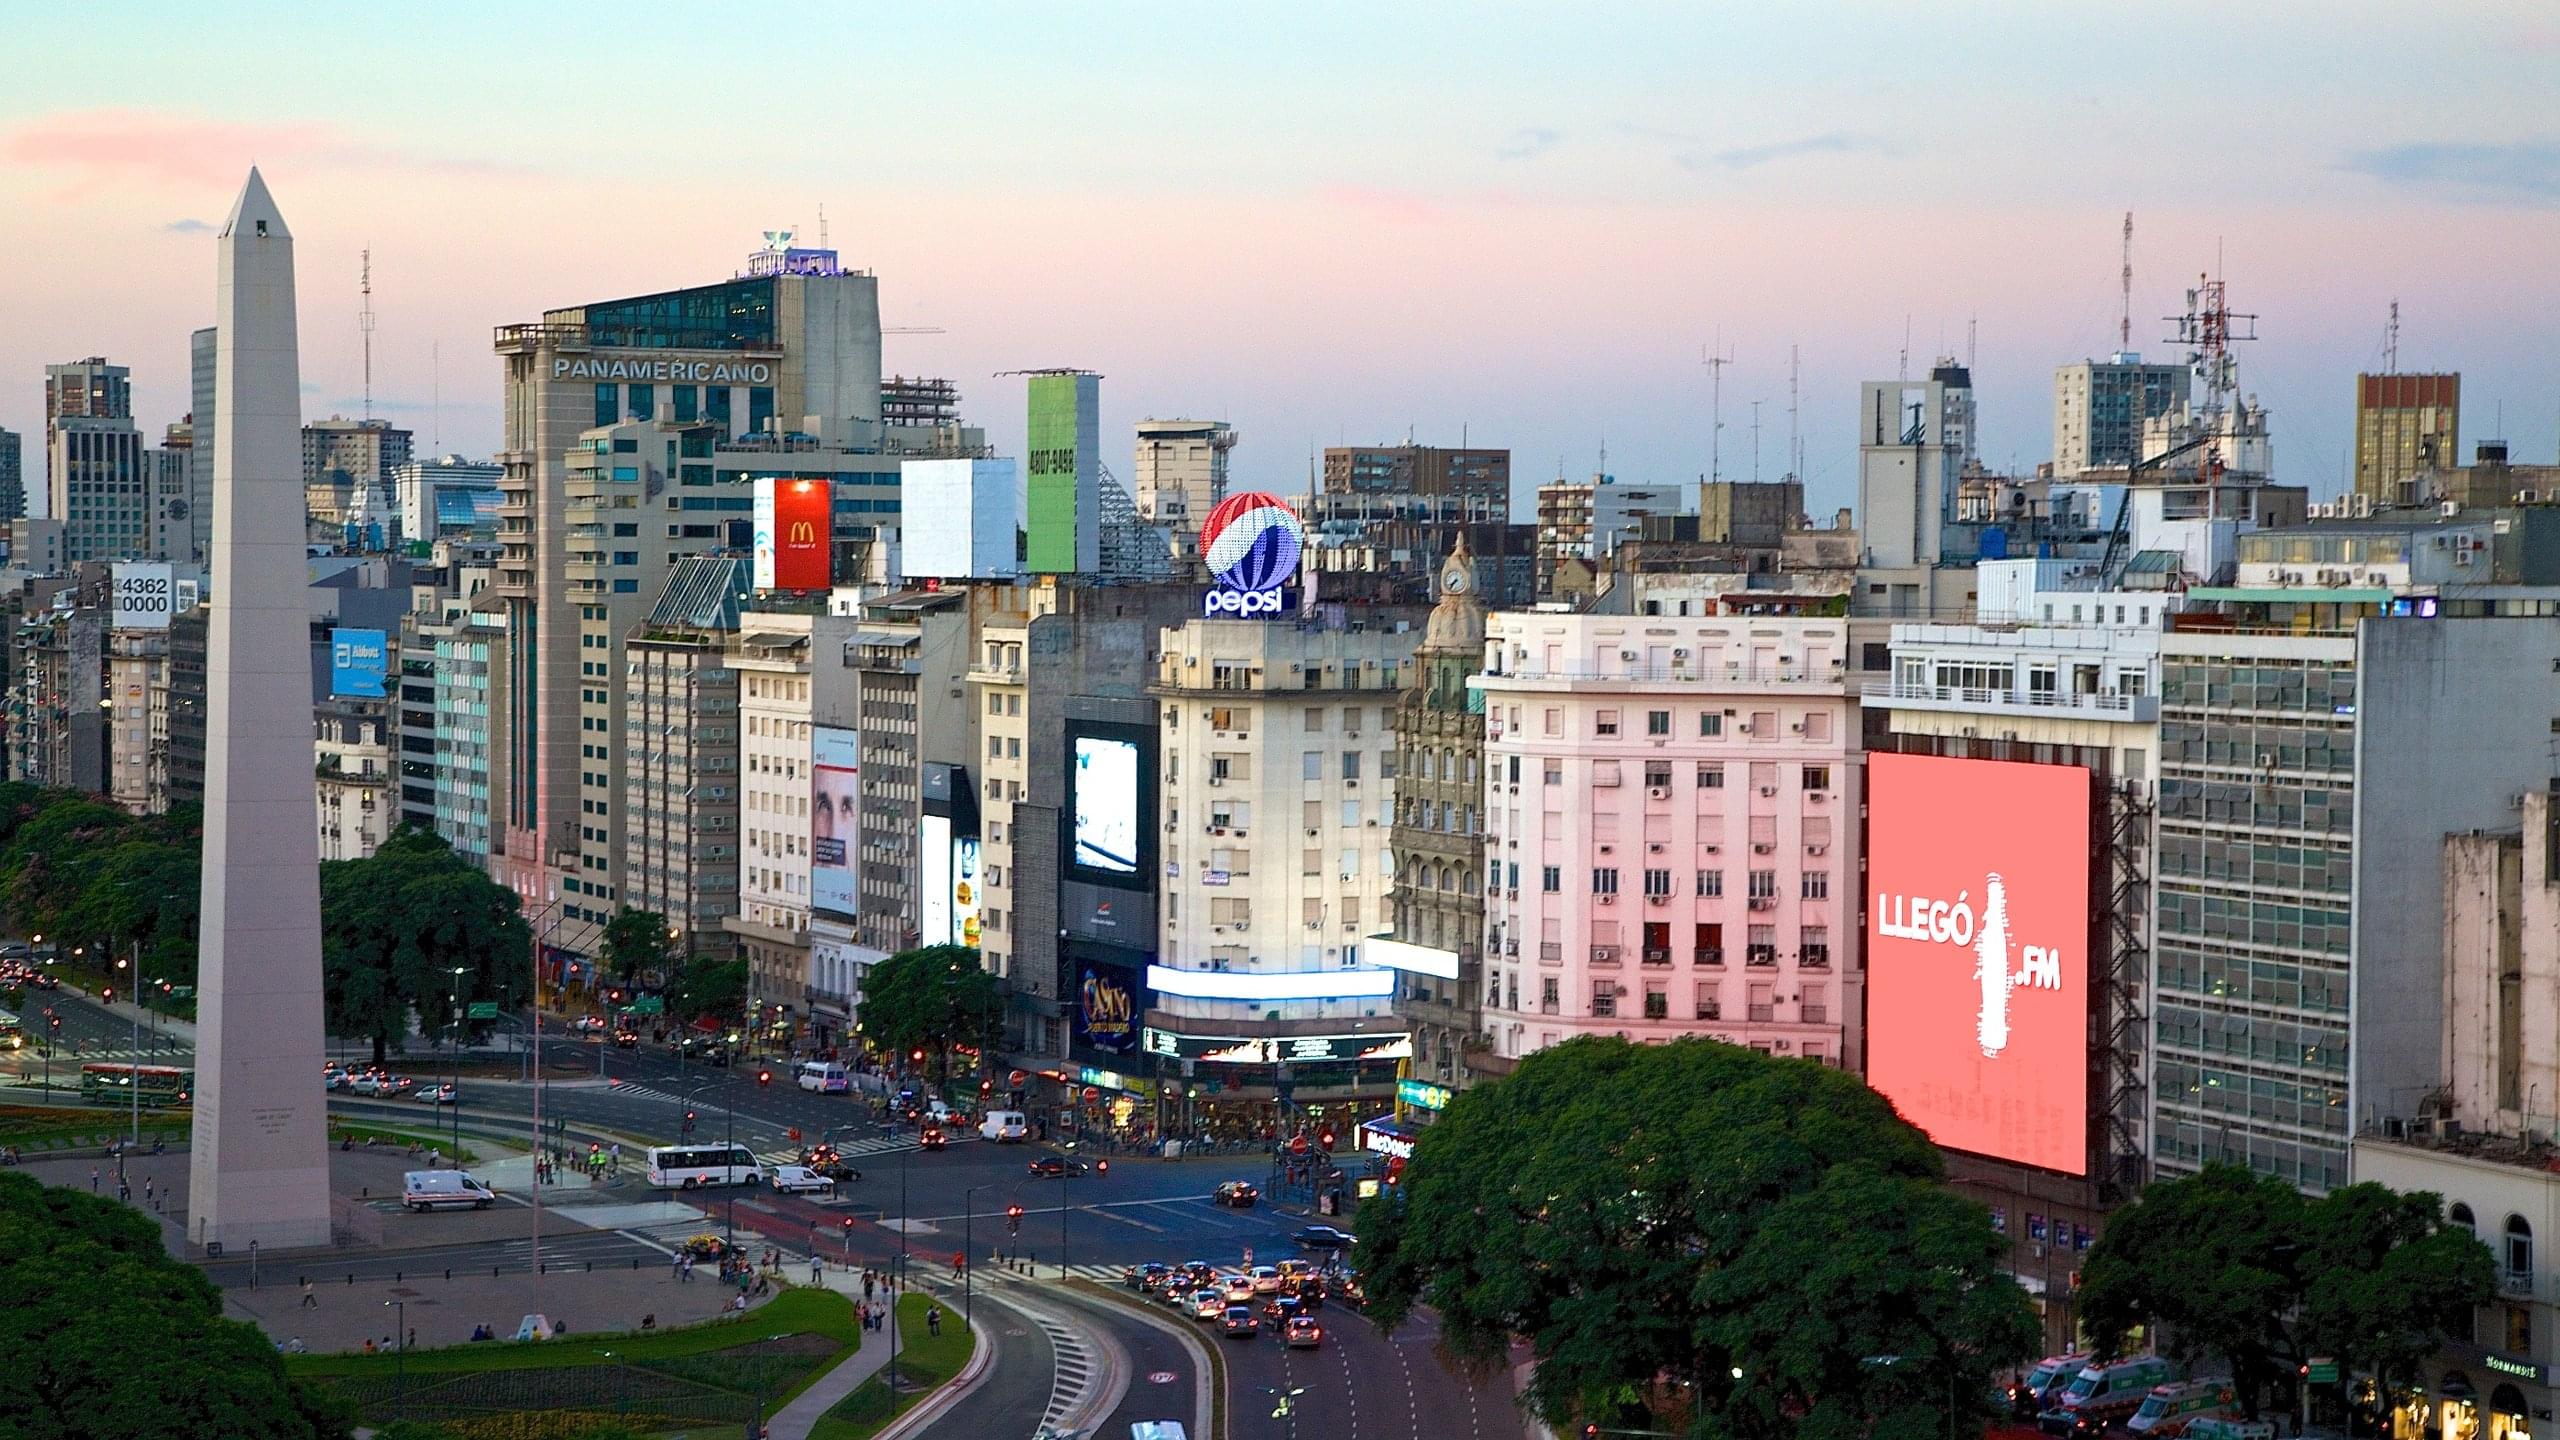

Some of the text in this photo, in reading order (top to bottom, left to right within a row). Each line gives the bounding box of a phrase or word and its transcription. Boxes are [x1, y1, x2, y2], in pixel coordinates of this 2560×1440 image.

[554, 358, 769, 383] PANAMERICANO
[122, 578, 167, 594] 4362
[123, 596, 167, 612] 0000
[1205, 586, 1282, 617] pepsi
[1879, 889, 1974, 947] LLEGÓ
